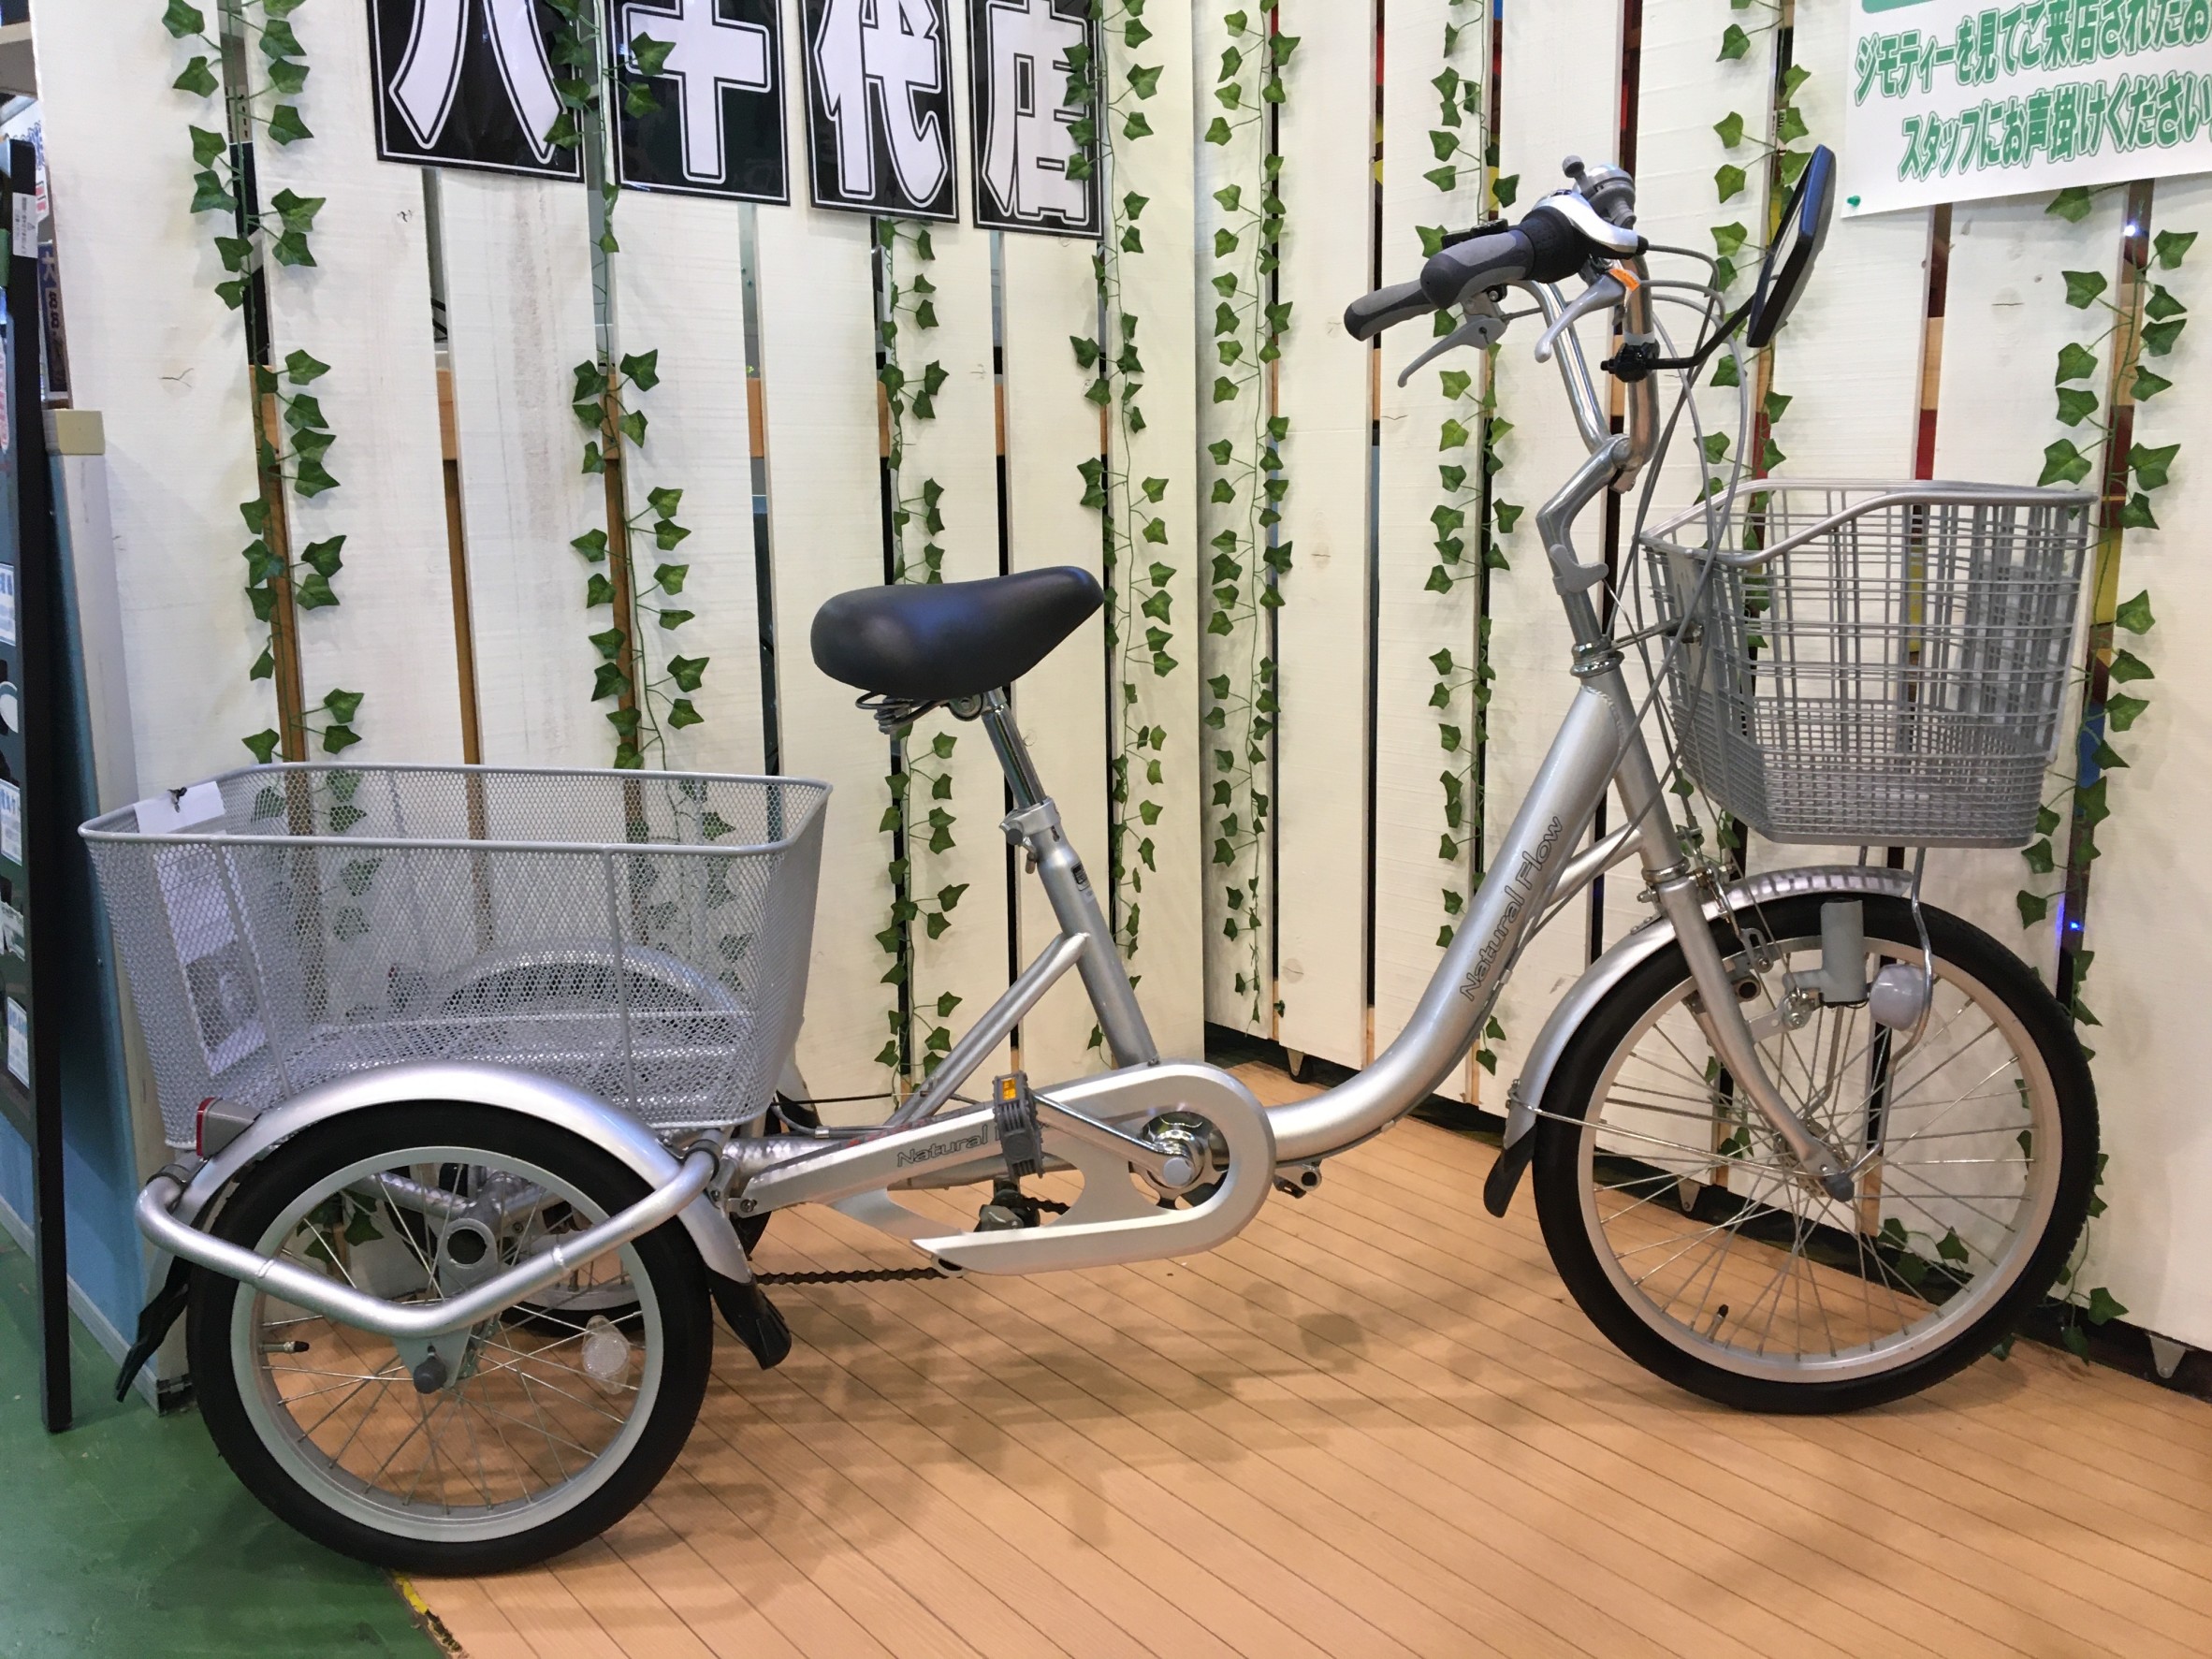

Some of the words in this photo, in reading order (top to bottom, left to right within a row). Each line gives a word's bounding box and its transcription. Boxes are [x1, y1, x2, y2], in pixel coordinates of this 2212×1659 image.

[1898, 69, 2212, 182] スタッフにお声掛けください
[1460, 885, 1525, 1002] Natural
[1515, 816, 1564, 891] Flow
[896, 1124, 988, 1168] Natural
